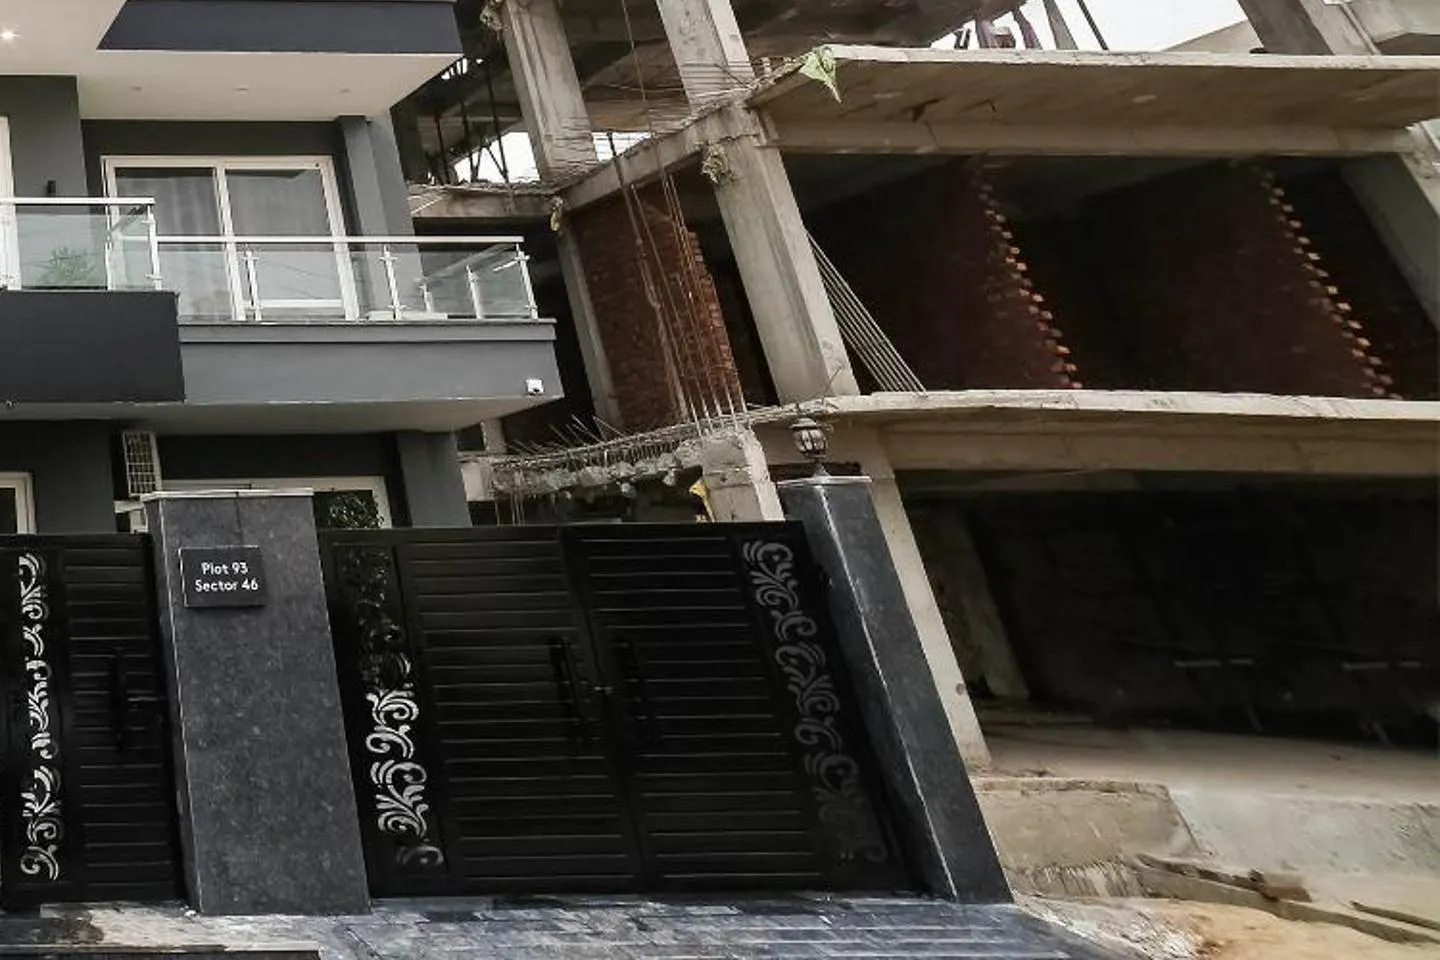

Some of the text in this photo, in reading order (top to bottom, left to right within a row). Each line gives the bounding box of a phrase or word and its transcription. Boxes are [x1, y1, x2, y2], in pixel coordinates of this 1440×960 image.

[201, 561, 249, 575] Plot 93
[195, 577, 259, 593] Sector 46
